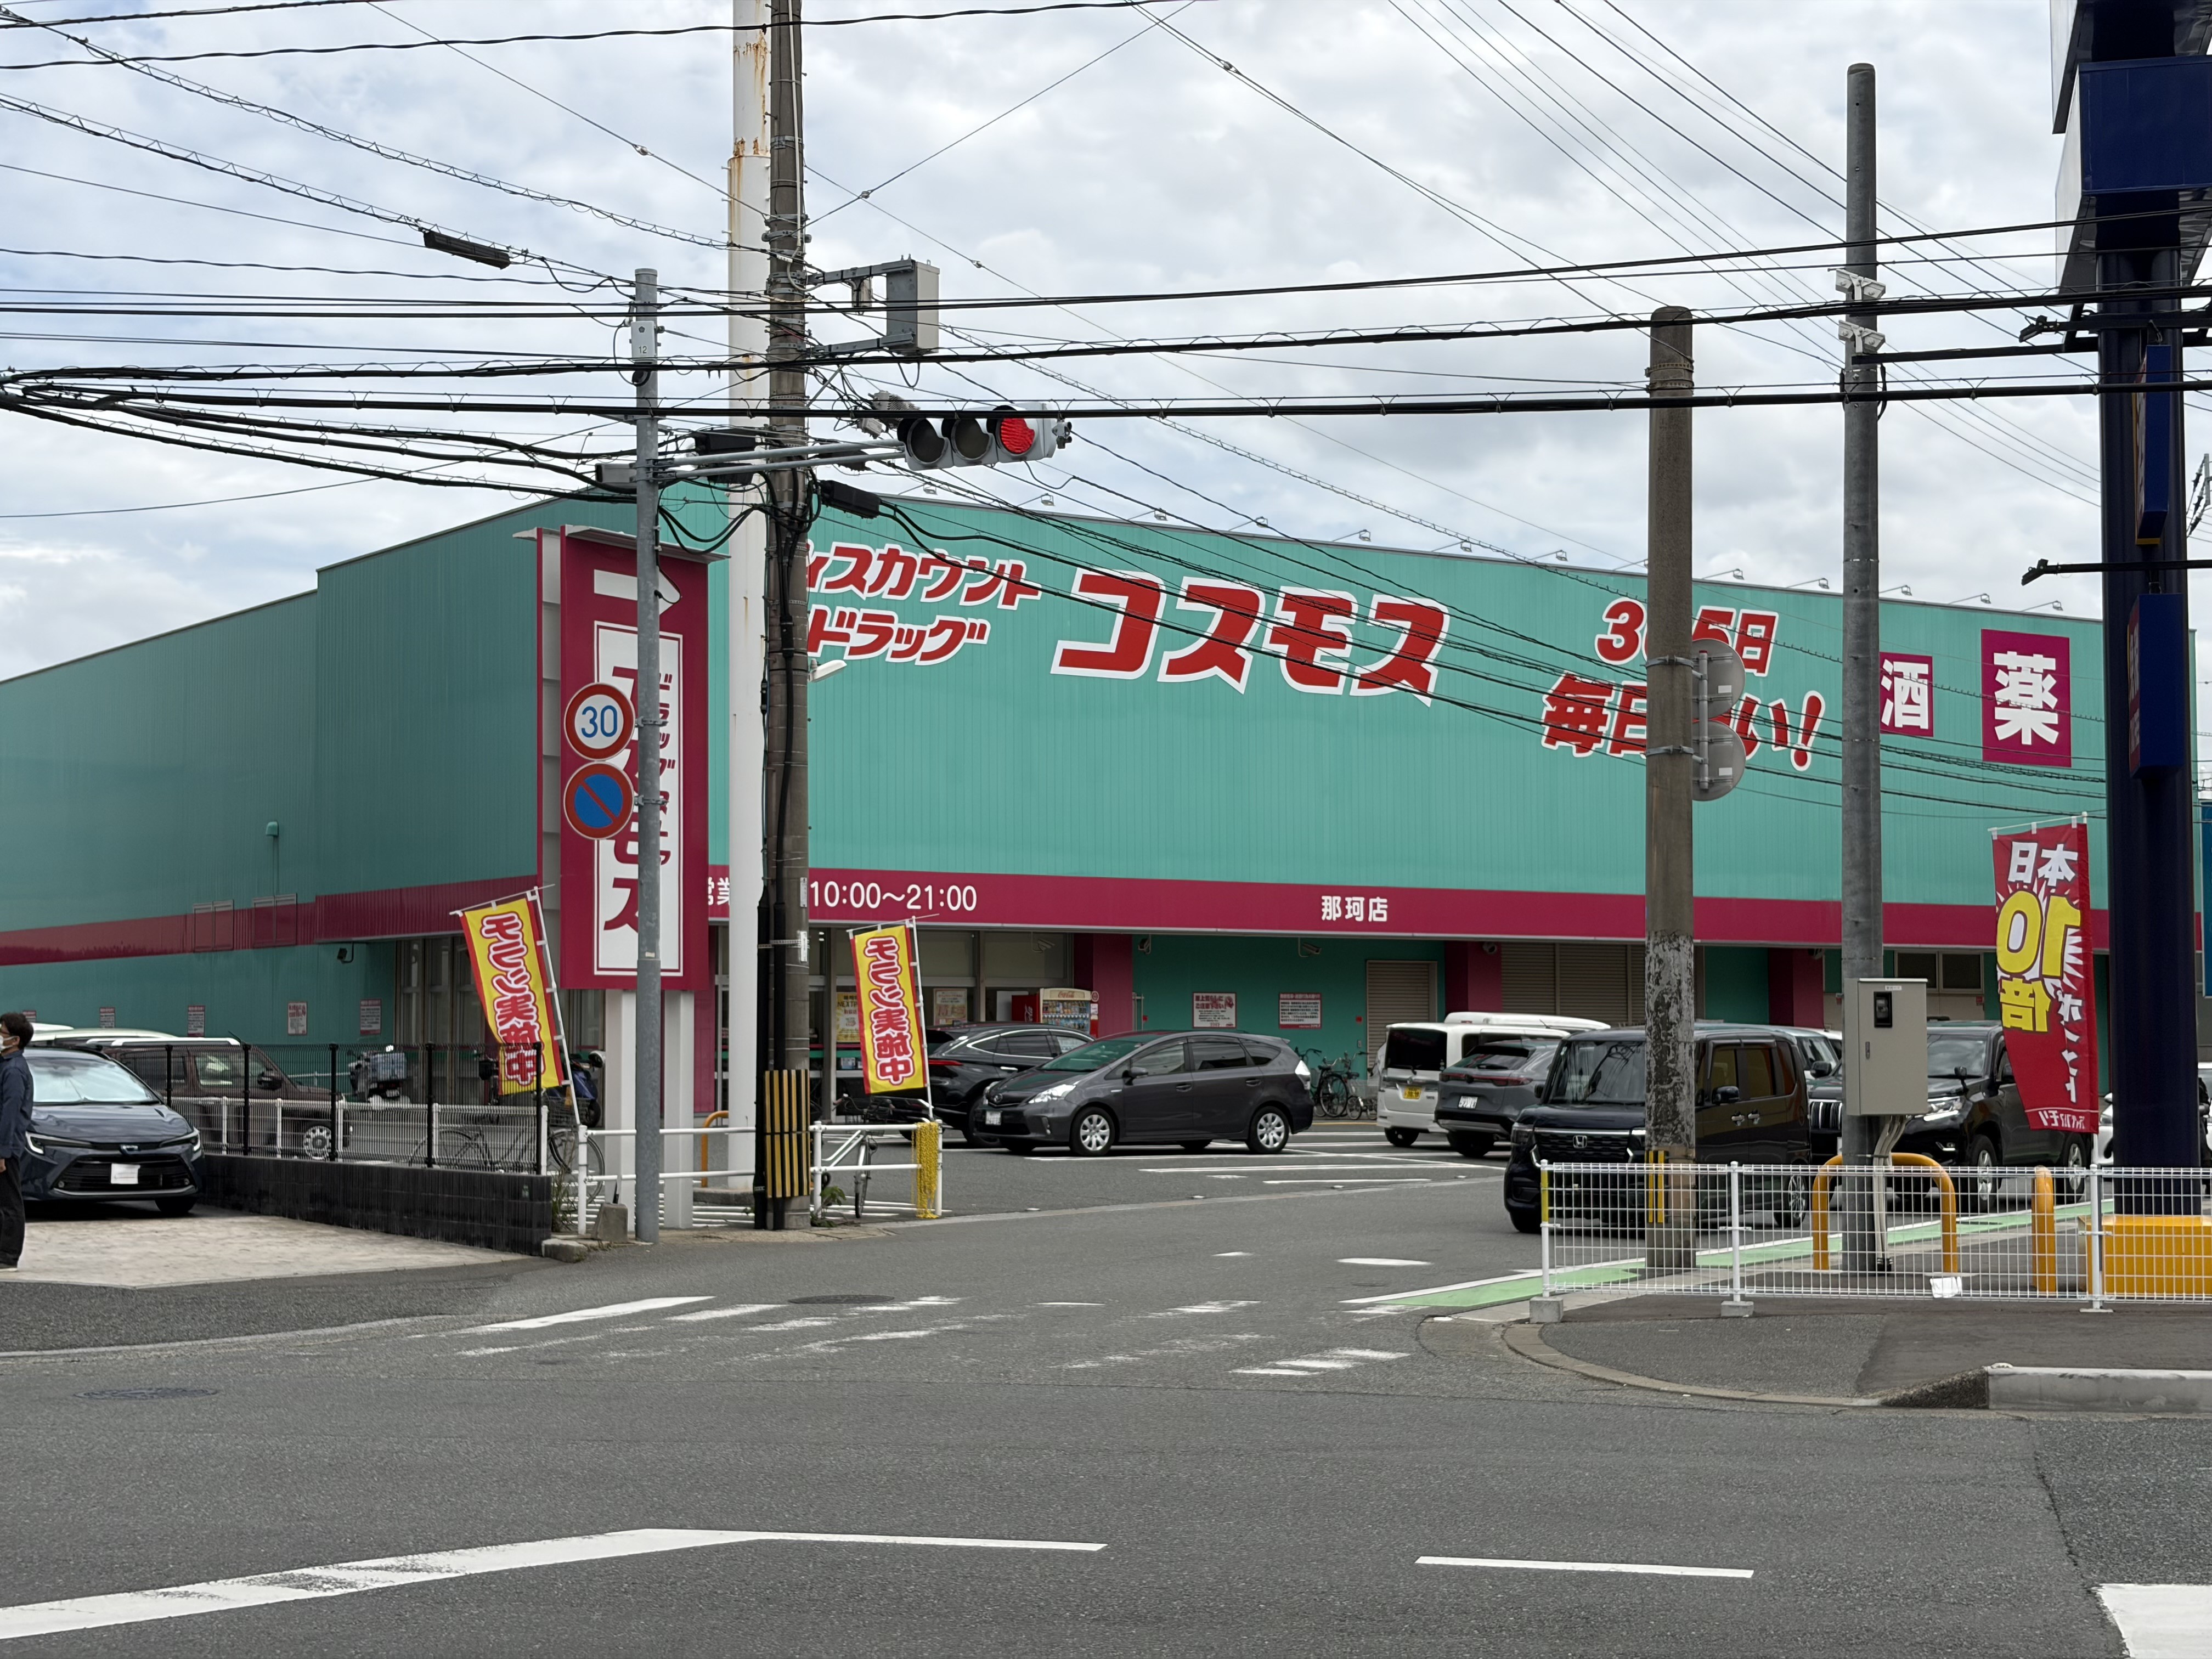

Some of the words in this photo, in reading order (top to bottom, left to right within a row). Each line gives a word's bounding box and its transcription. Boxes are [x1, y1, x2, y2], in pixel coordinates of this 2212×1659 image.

[806, 539, 1041, 610] ィスカウント
[808, 605, 991, 665] ドラッグ
[1050, 567, 1450, 707] コスモス
[1595, 597, 1779, 677] 35日
[581, 705, 618, 738] 30
[1541, 670, 1825, 771] 毎日い!
[1881, 659, 1929, 730] 酒
[1994, 651, 2059, 745] 薬
[1321, 895, 1388, 922] 那珂店
